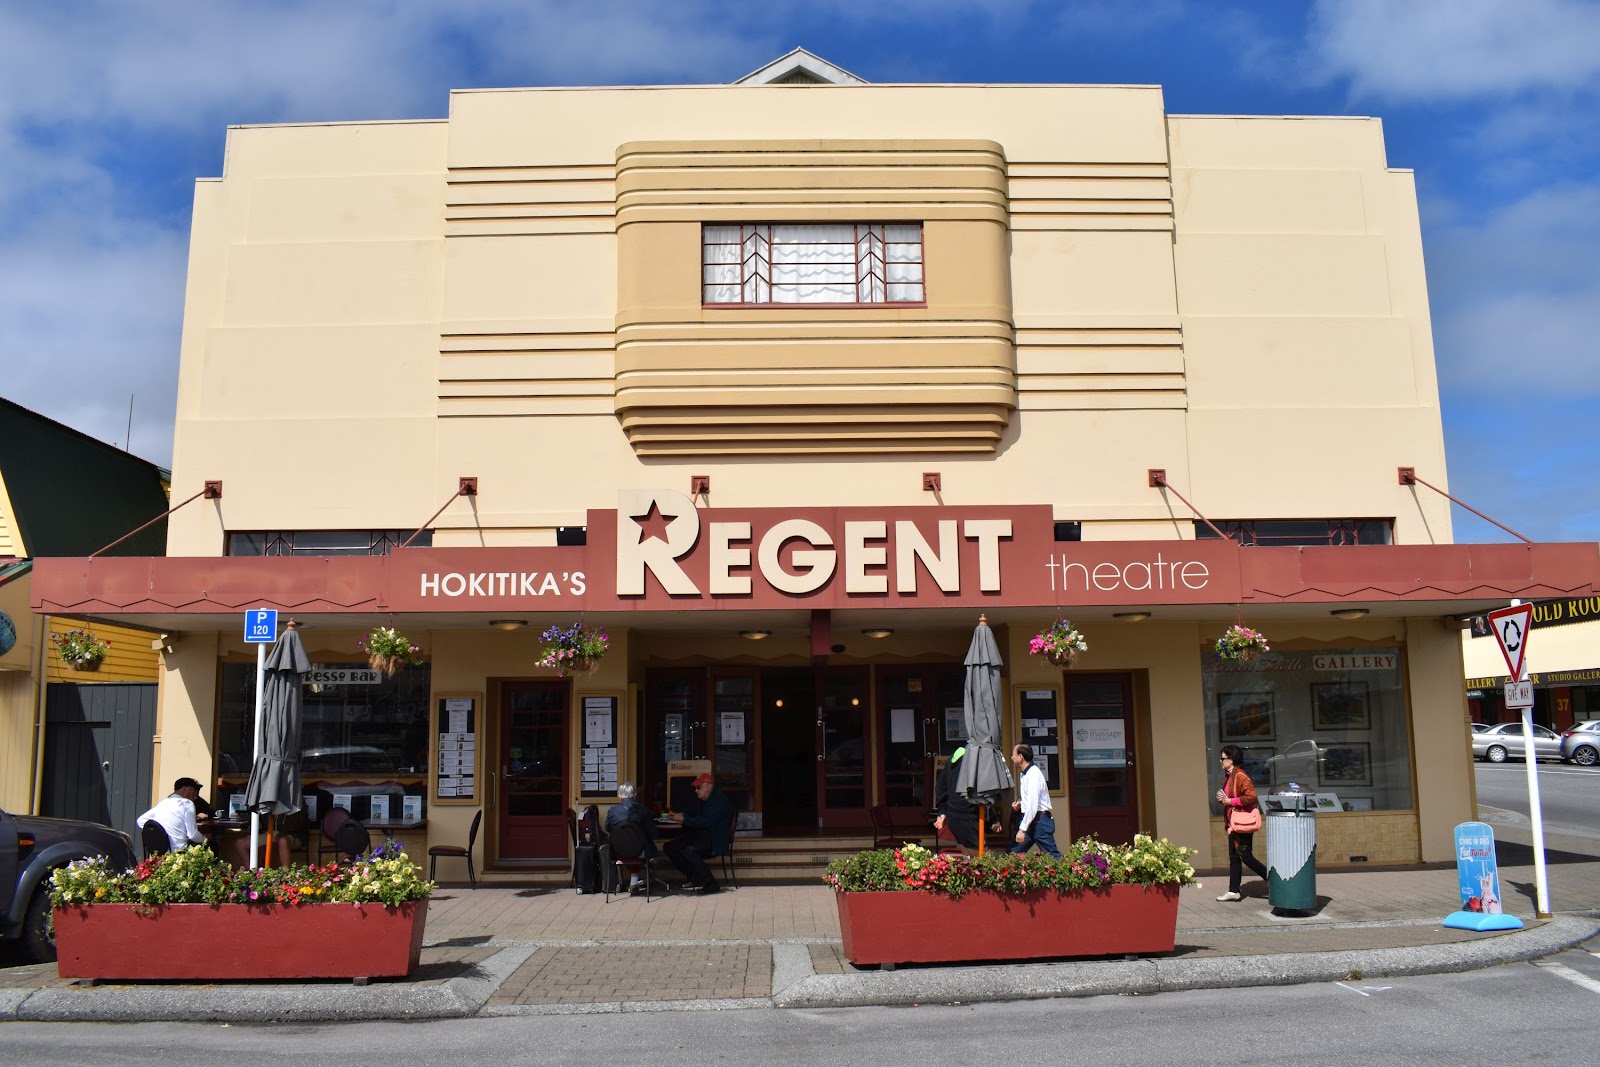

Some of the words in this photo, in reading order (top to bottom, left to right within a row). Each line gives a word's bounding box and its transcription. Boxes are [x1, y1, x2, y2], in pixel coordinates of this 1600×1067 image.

[420, 571, 587, 597] HOKITIKA'S
[616, 488, 1012, 596] REGENT
[1045, 553, 1210, 591] theatre
[1532, 603, 1562, 622] OLD
[1568, 596, 1600, 618] ROO
[257, 611, 268, 624] P
[253, 625, 269, 635] 120
[1314, 656, 1395, 669] GALLERY
[1466, 677, 1497, 688] ELLERY
[1547, 673, 1572, 682] STUDIO
[1573, 671, 1600, 681] GALLER
[1520, 688, 1529, 699] WAY
[1556, 698, 1569, 711] 37
[1089, 731, 1122, 740] massage
